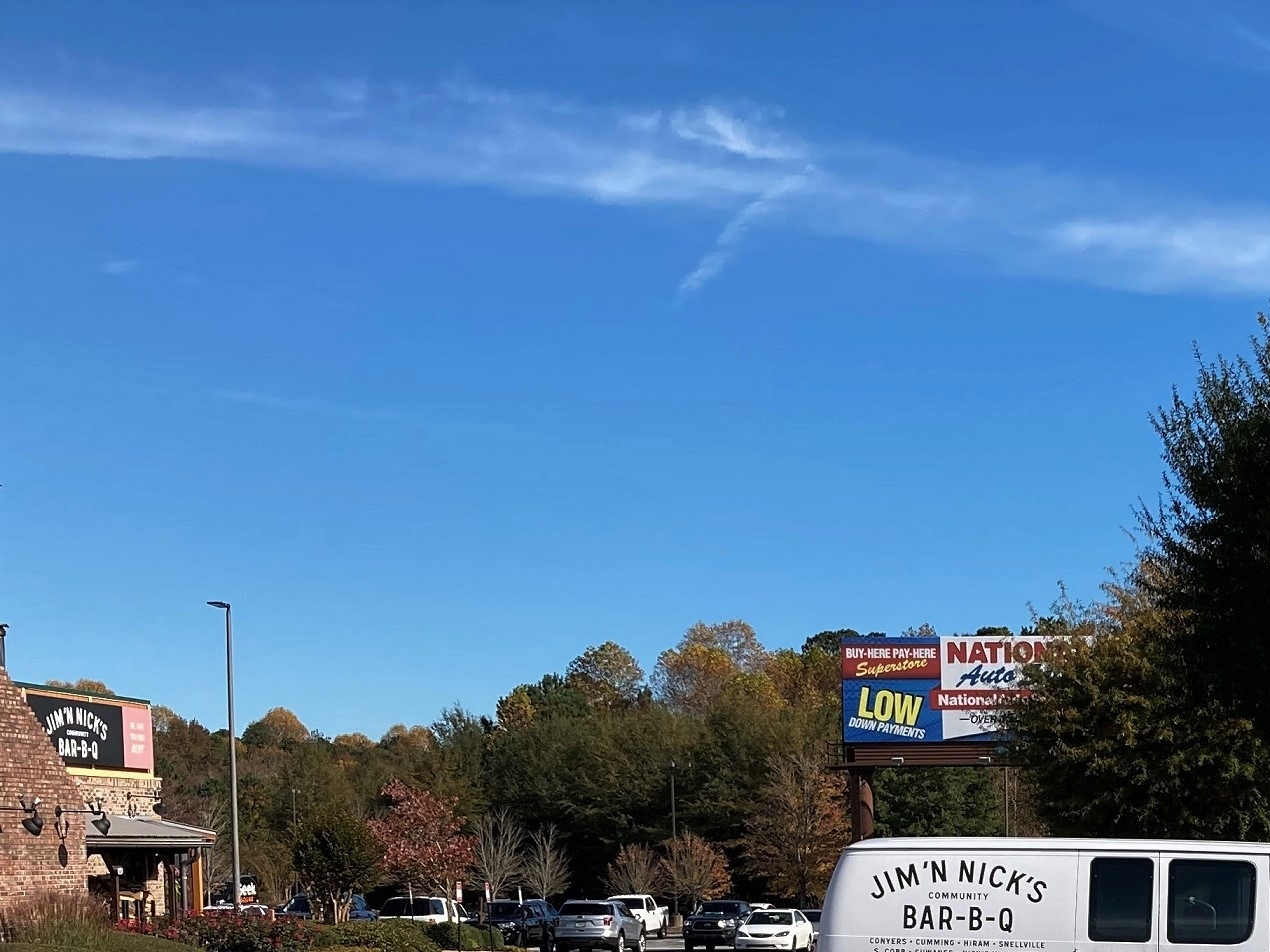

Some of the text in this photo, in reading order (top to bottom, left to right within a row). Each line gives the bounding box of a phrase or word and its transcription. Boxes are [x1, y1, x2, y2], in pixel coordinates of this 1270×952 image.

[845, 647, 937, 659] BUY-HERE PAY-HERE
[855, 658, 929, 678] Superstore
[956, 663, 1016, 688] Auto
[858, 686, 924, 727] LOW
[45, 706, 74, 735] JIM'N
[75, 706, 108, 741] NICK'S
[848, 716, 926, 740] DOWN PAYMENTS
[58, 737, 99, 761] BAR-B-Q
[958, 859, 1048, 903] NICK'S
[928, 891, 989, 901] COMMUNITY
[903, 904, 1013, 933] BAR-B-Q
[869, 937, 908, 945] CONYERS
[915, 938, 955, 946] CUMMING
[998, 941, 1046, 949] SNELLVILLE
